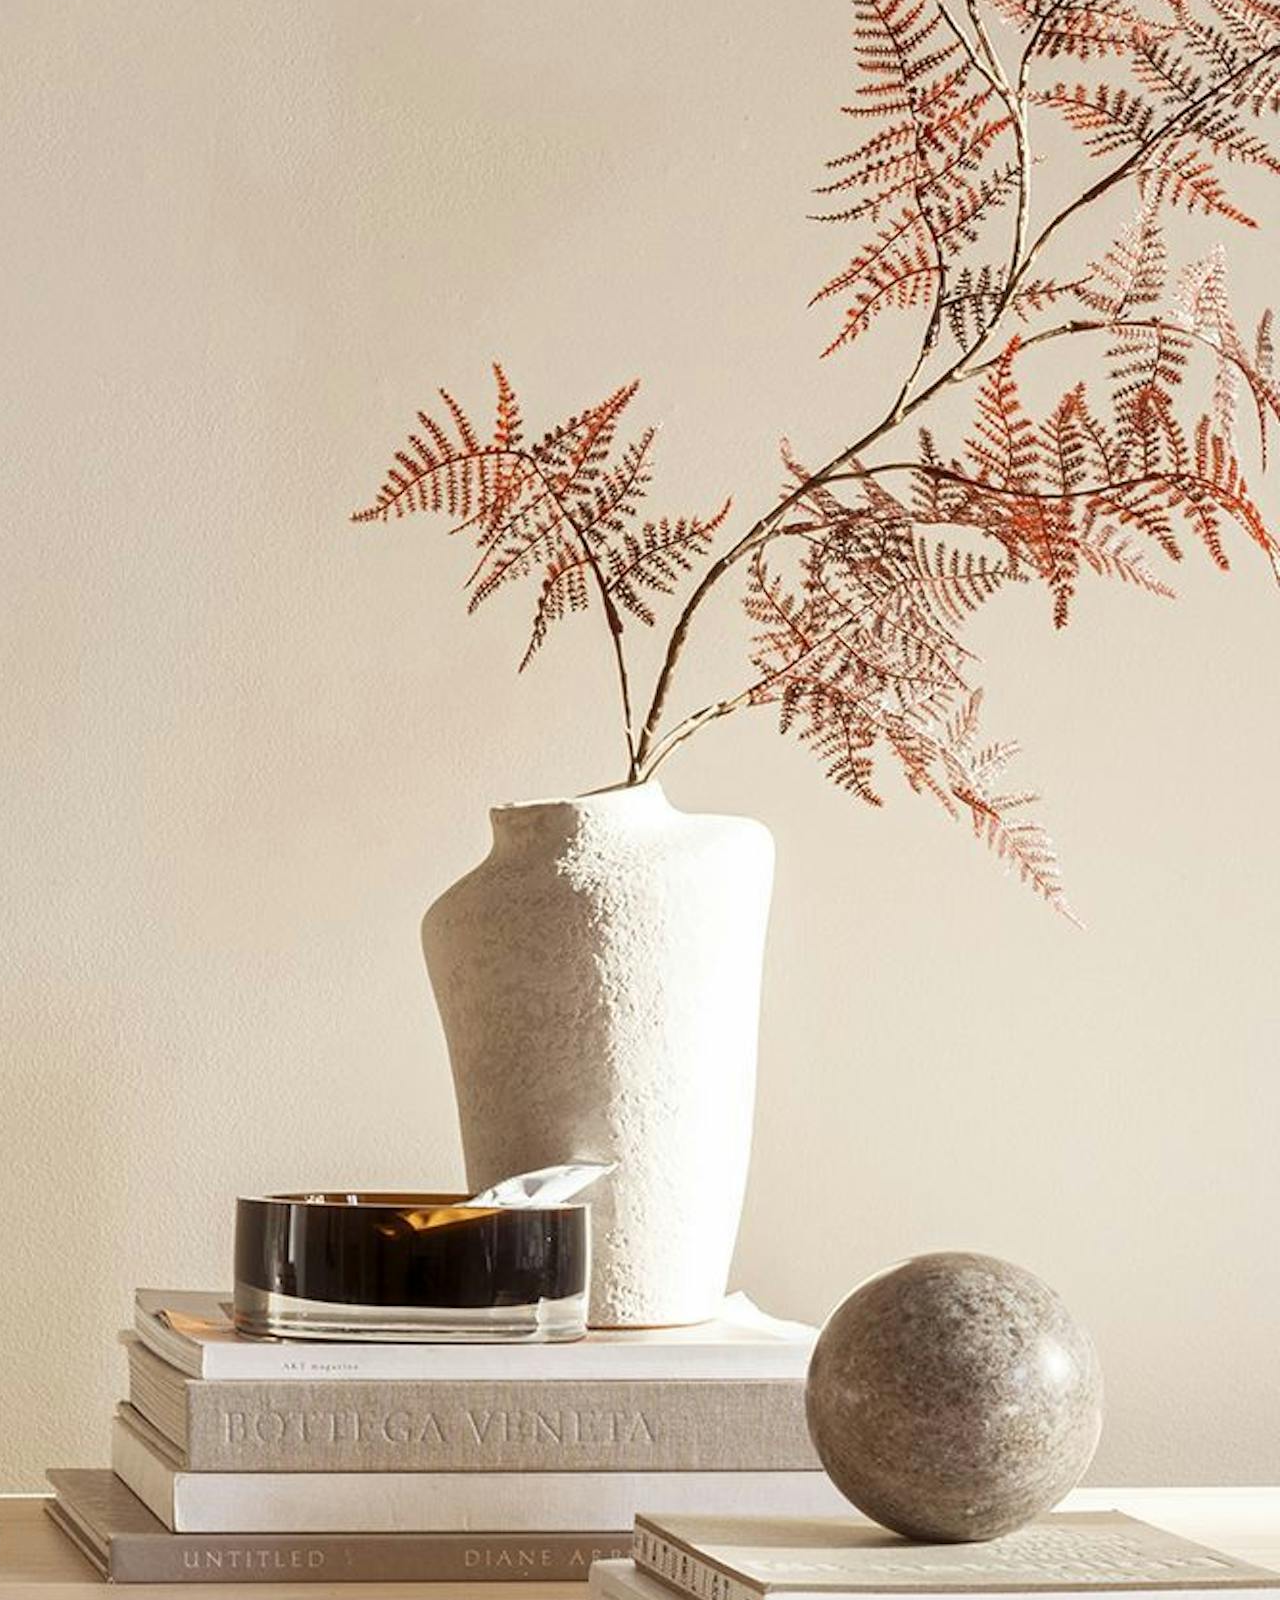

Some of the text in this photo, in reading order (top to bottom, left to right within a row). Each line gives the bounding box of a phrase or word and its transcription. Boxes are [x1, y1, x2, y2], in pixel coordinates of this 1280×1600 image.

[223, 1410, 657, 1445] BOTTEGA VENETA
[184, 1550, 325, 1567] UNTITLED
[464, 1550, 552, 1567] DIANE
